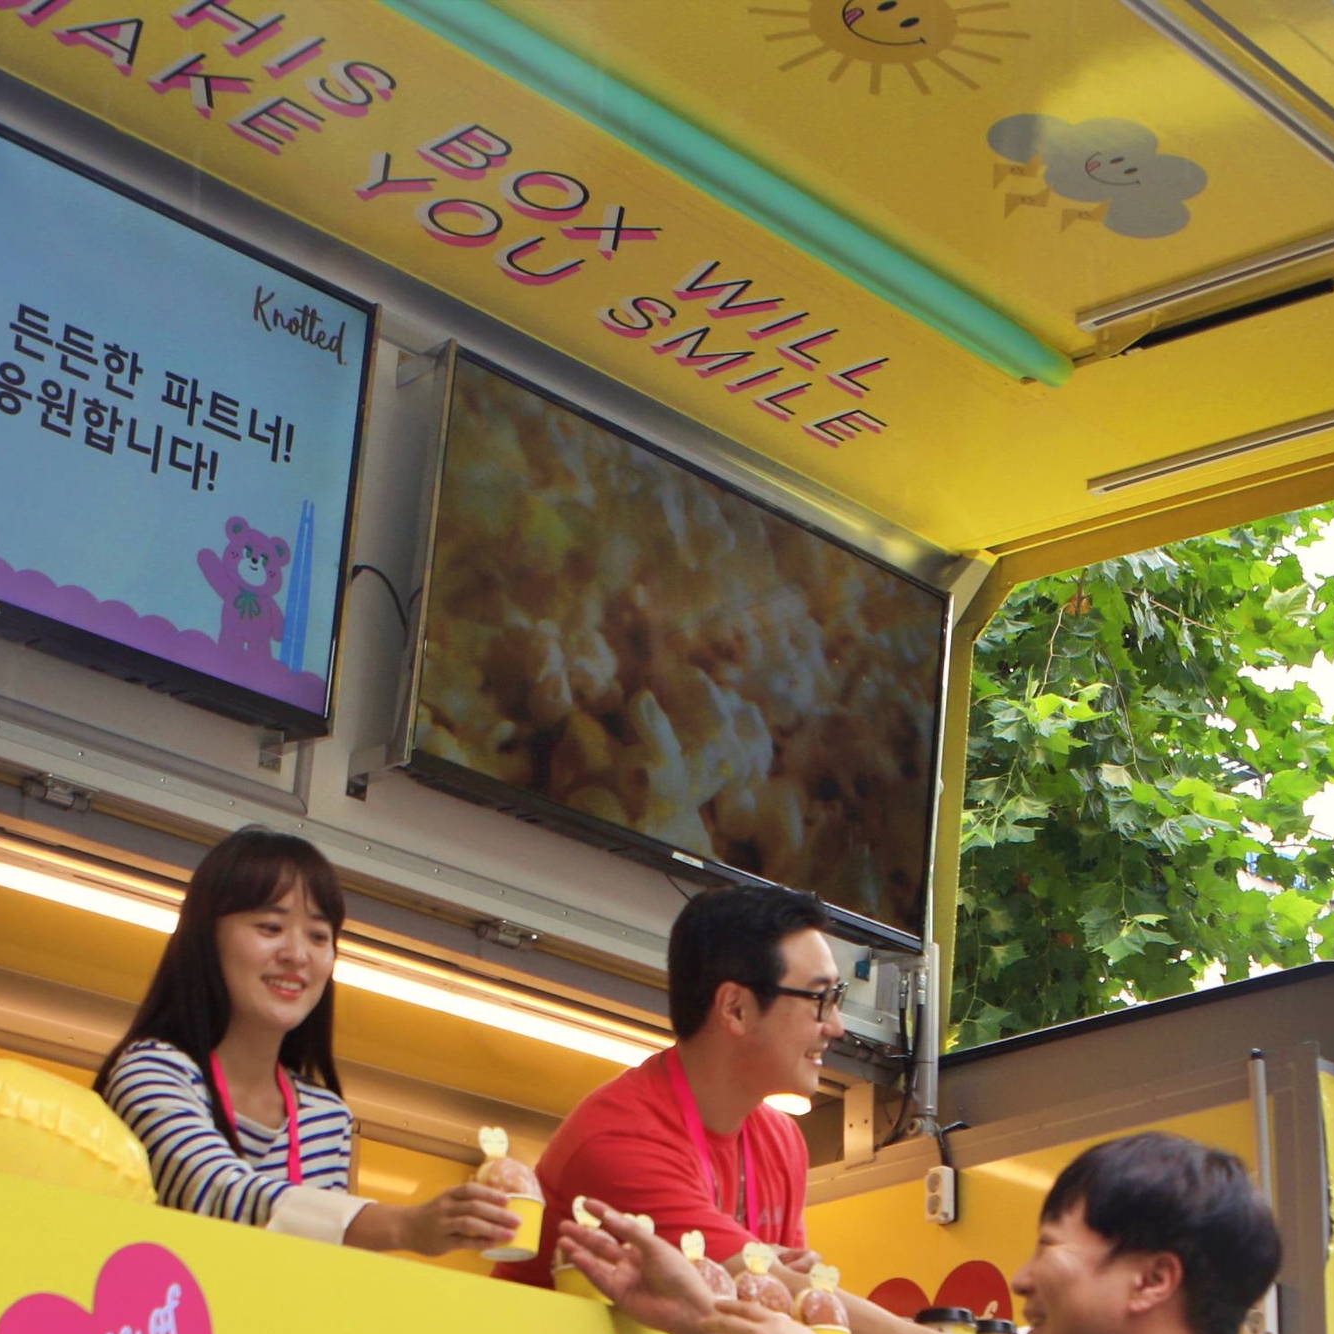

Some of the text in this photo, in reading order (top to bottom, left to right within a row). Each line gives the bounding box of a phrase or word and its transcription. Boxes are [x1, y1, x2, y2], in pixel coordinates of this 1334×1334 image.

[9, 303, 144, 400] 든든한
[161, 370, 296, 464] 파트너!
[354, 152, 586, 286] YOU
[597, 296, 888, 448] SMILE
[417, 124, 663, 260] BOX
[673, 260, 890, 398] WILL
